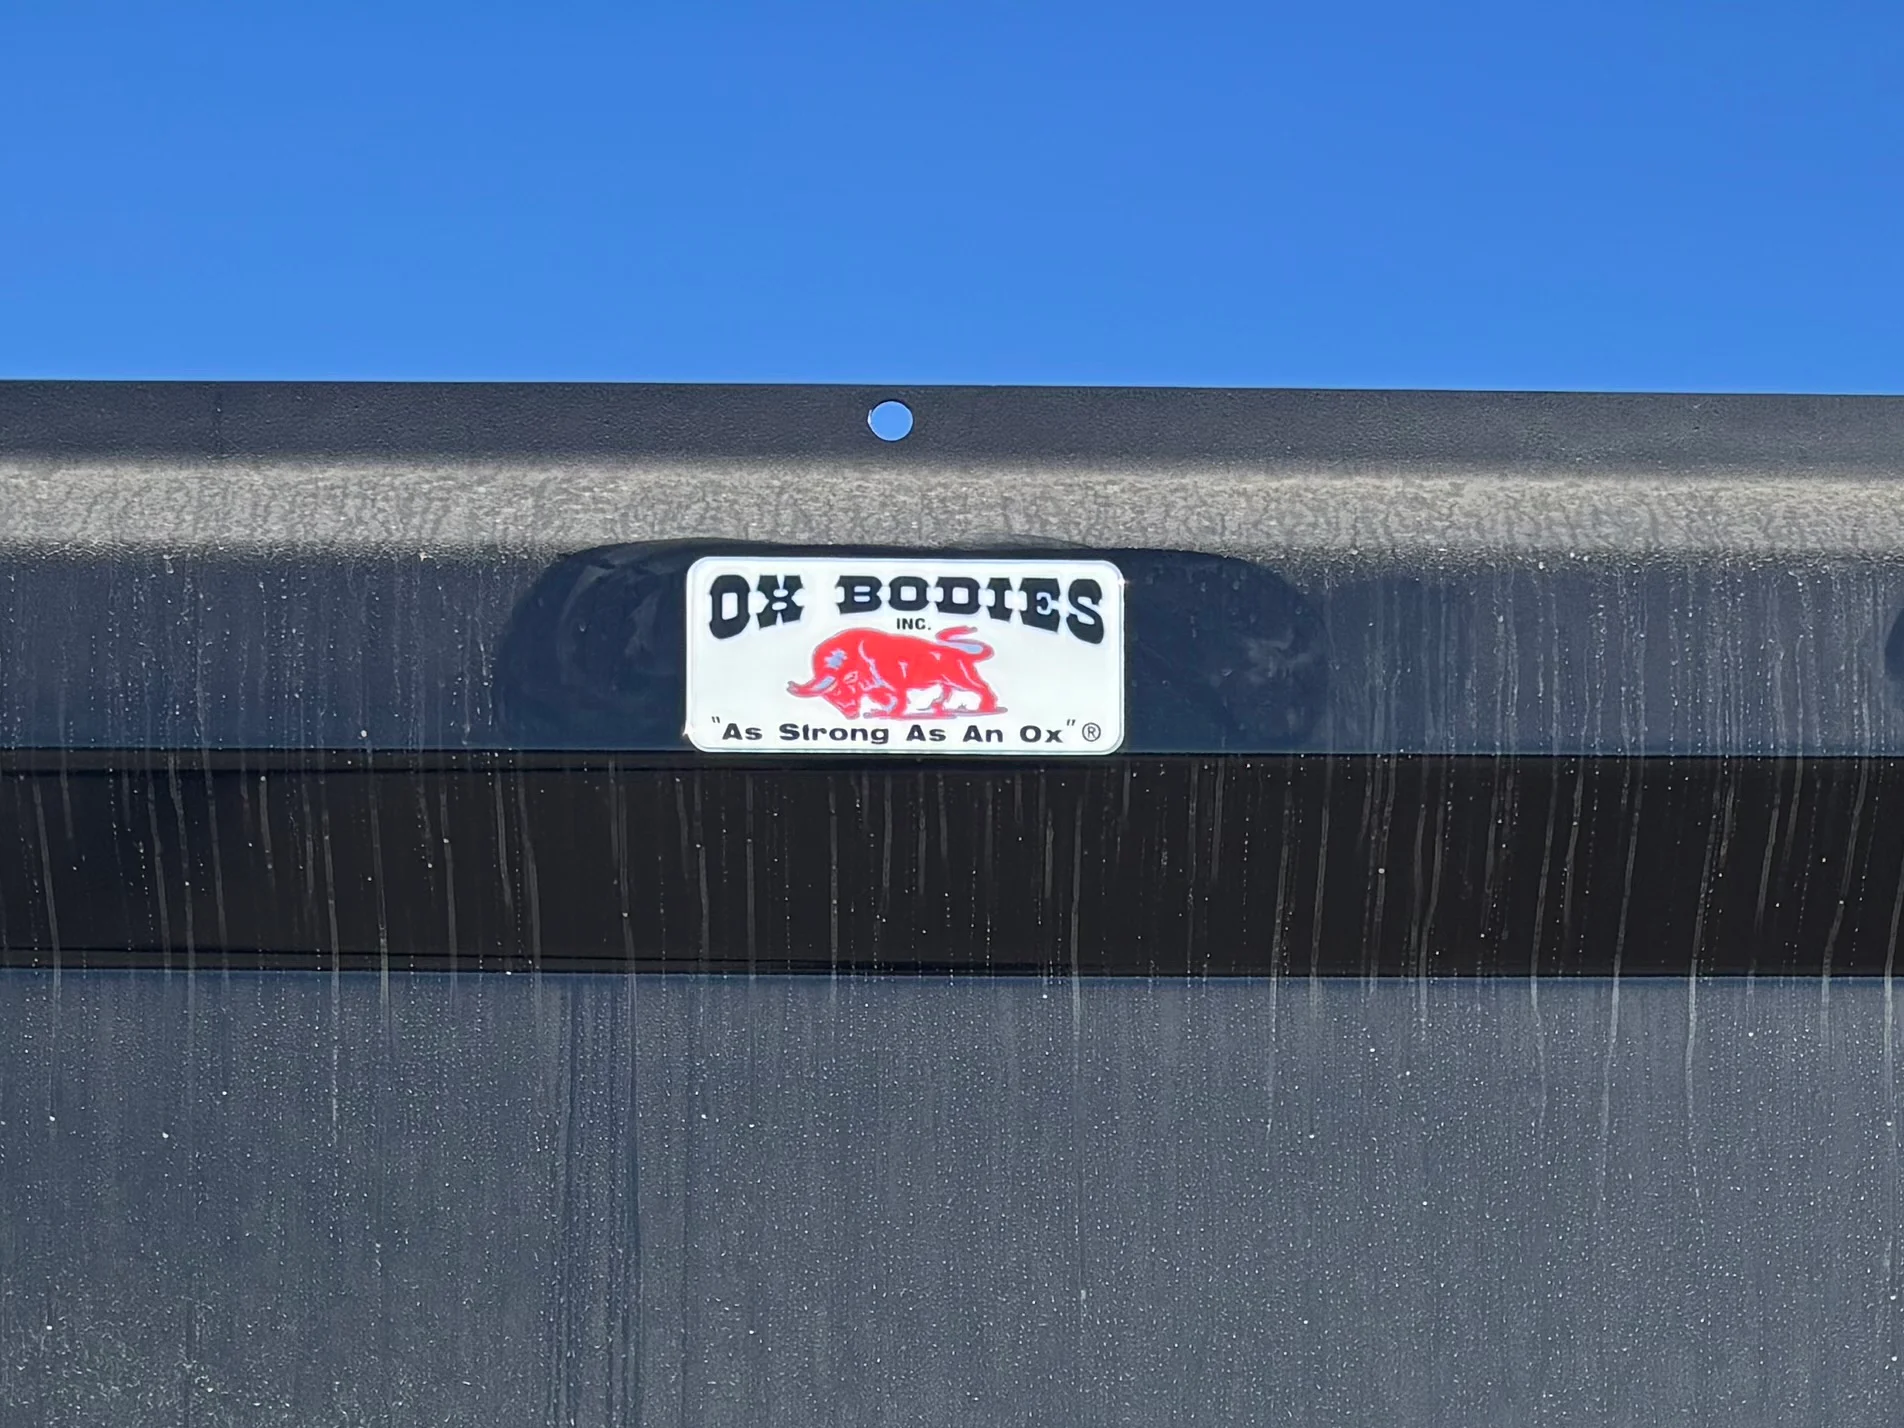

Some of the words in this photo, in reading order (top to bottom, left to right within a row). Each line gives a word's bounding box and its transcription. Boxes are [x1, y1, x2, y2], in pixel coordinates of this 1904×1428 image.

[709, 575, 803, 639] OX
[836, 576, 1104, 644] BODIES
[896, 617, 931, 631] INC.
[780, 724, 888, 744] Strong
[907, 725, 945, 741] As
[963, 726, 1002, 742] An
